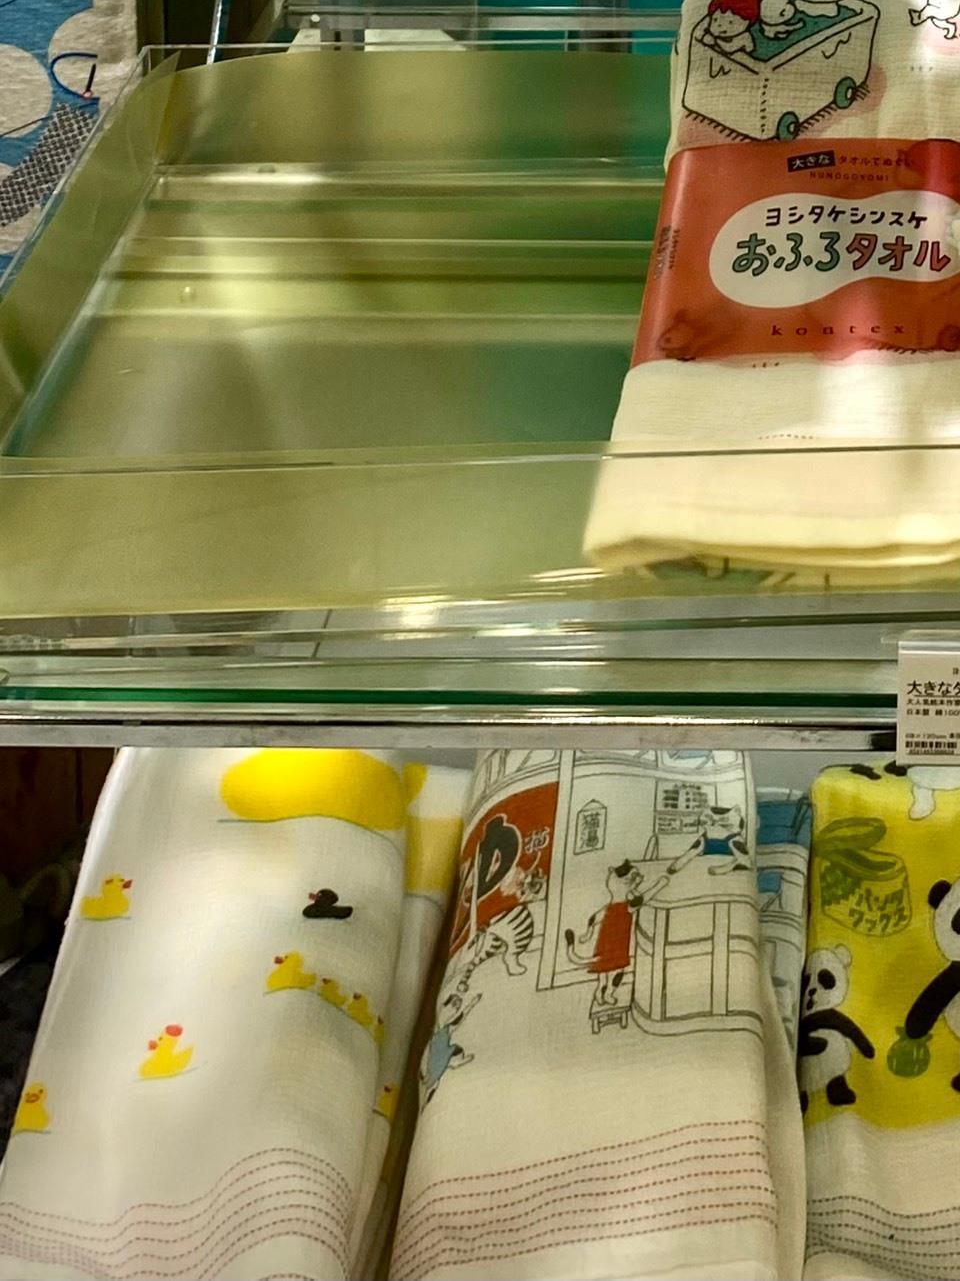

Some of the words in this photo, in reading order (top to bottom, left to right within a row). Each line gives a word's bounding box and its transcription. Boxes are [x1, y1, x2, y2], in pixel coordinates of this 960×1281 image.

[792, 154, 831, 169] 大きな
[766, 205, 928, 229] ヨシタケシンスケ
[732, 231, 952, 276] おふろタオル
